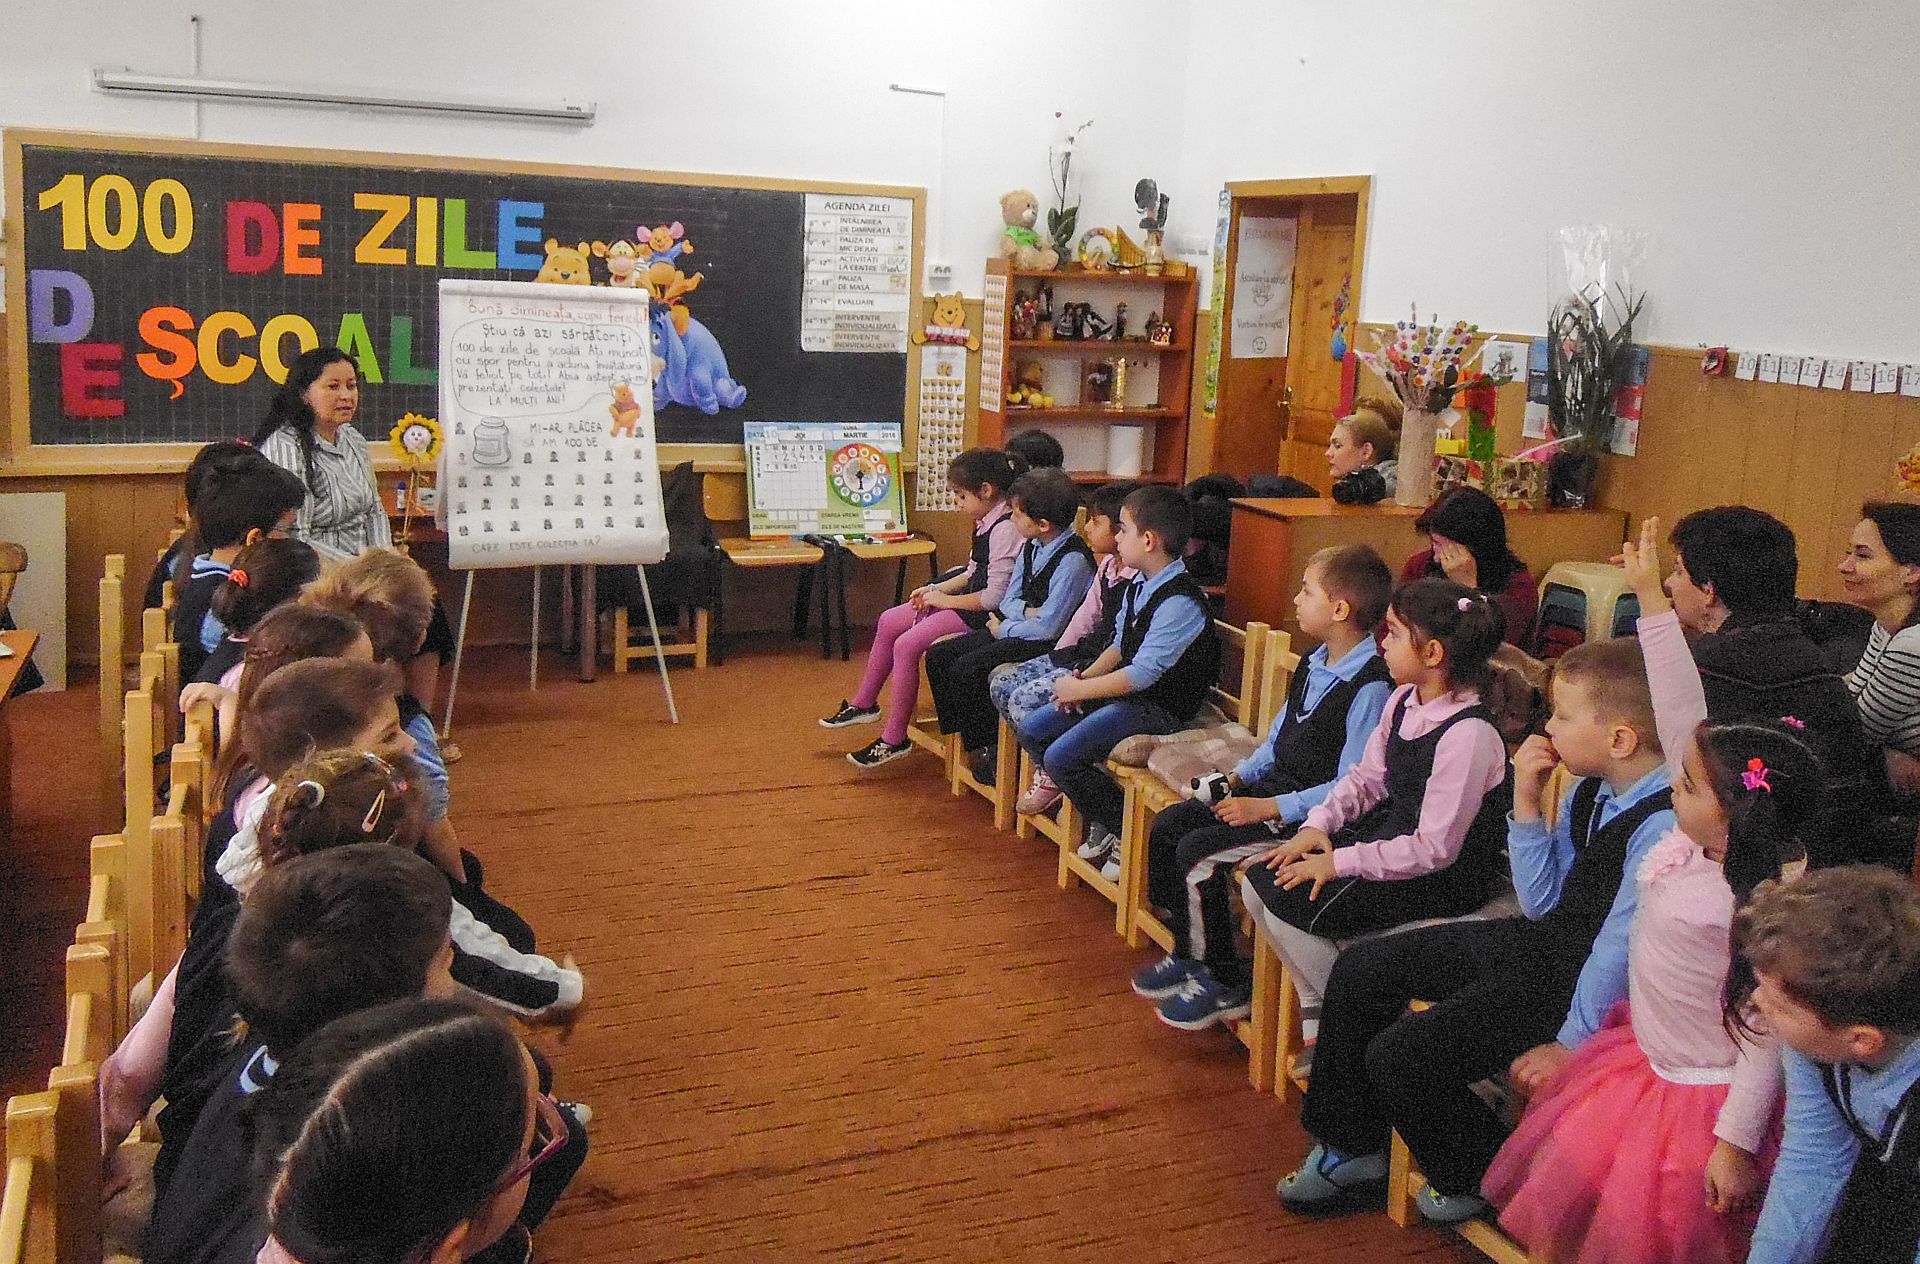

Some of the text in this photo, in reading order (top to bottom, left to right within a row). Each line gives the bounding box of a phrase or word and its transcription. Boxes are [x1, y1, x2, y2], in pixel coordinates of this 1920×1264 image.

[824, 201, 891, 212] AGENDA ZILEI
[38, 174, 544, 275] 100 DE ZILE
[534, 328, 552, 338] azi
[458, 342, 475, 353] 100
[479, 339, 494, 353] de
[500, 340, 519, 353] zile
[525, 342, 540, 356] de
[455, 356, 470, 365] cu
[506, 355, 541, 374] pentru
[546, 360, 554, 368] a
[1739, 357, 1756, 371] 10
[1761, 358, 1777, 373] 11
[1783, 361, 1798, 374] 12
[1804, 363, 1820, 377] 13
[1827, 364, 1846, 378] 14
[1854, 368, 1871, 381] 15
[1877, 368, 1896, 383] 16
[1904, 371, 1920, 386] 17
[489, 395, 503, 406] LA
[564, 437, 582, 448] 100
[587, 437, 600, 448] DE
